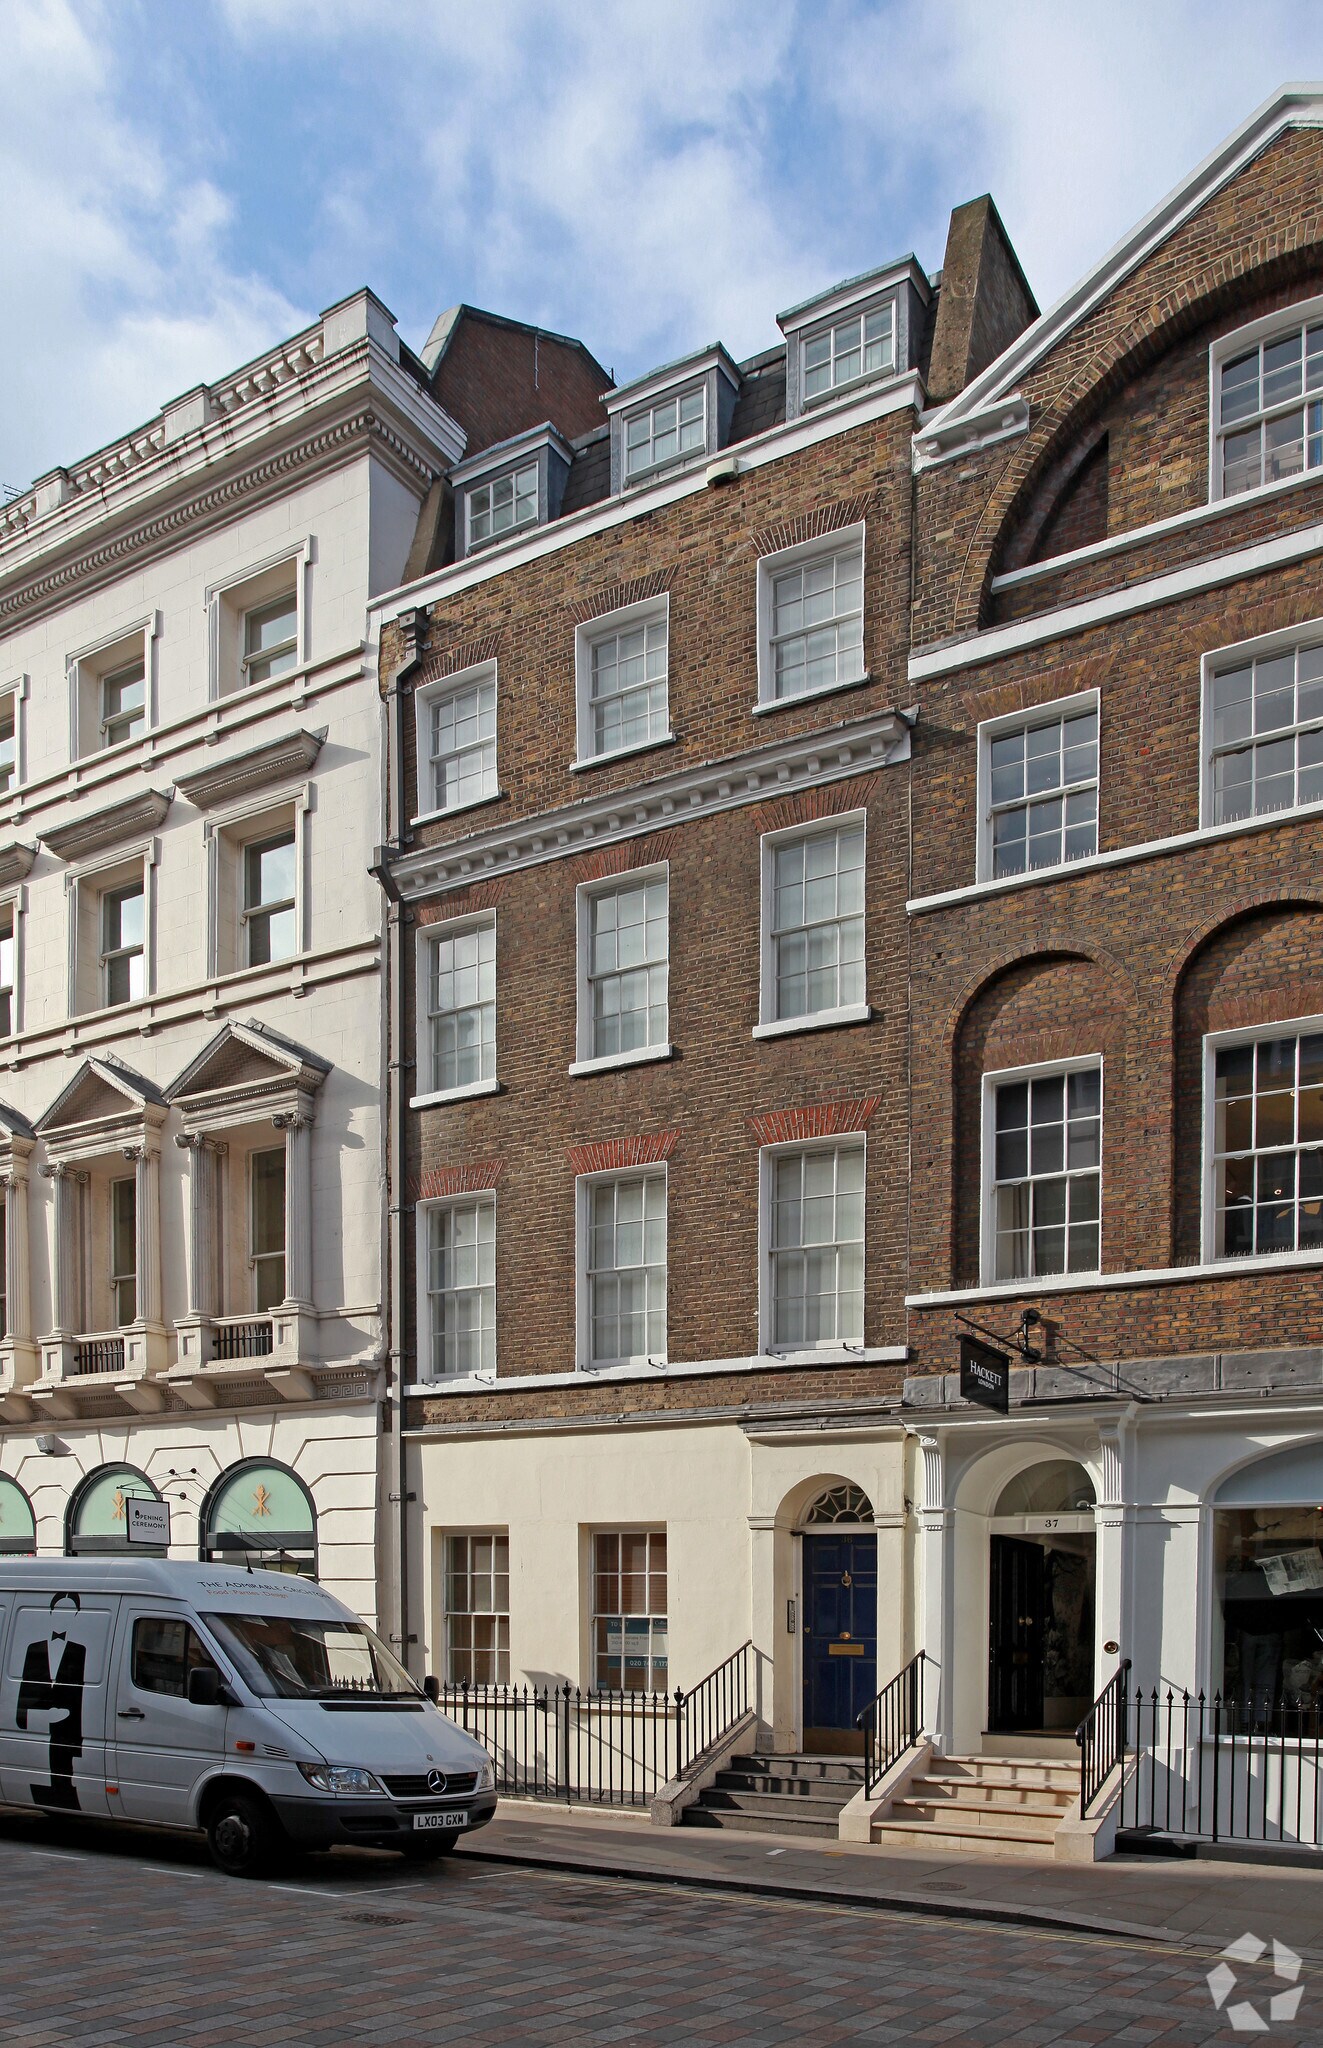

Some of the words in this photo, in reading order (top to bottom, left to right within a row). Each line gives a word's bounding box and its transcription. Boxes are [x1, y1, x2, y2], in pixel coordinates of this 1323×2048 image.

[970, 1359, 1002, 1386] HACKETT
[977, 1378, 995, 1390] LONDON
[134, 1509, 163, 1521] OPENING
[132, 1520, 166, 1529] CEREMONY
[1044, 1519, 1059, 1528] 37
[225, 1581, 280, 1591] ADMIRABLE
[417, 1815, 443, 1827] LX03
[445, 1814, 464, 1825] GXM
